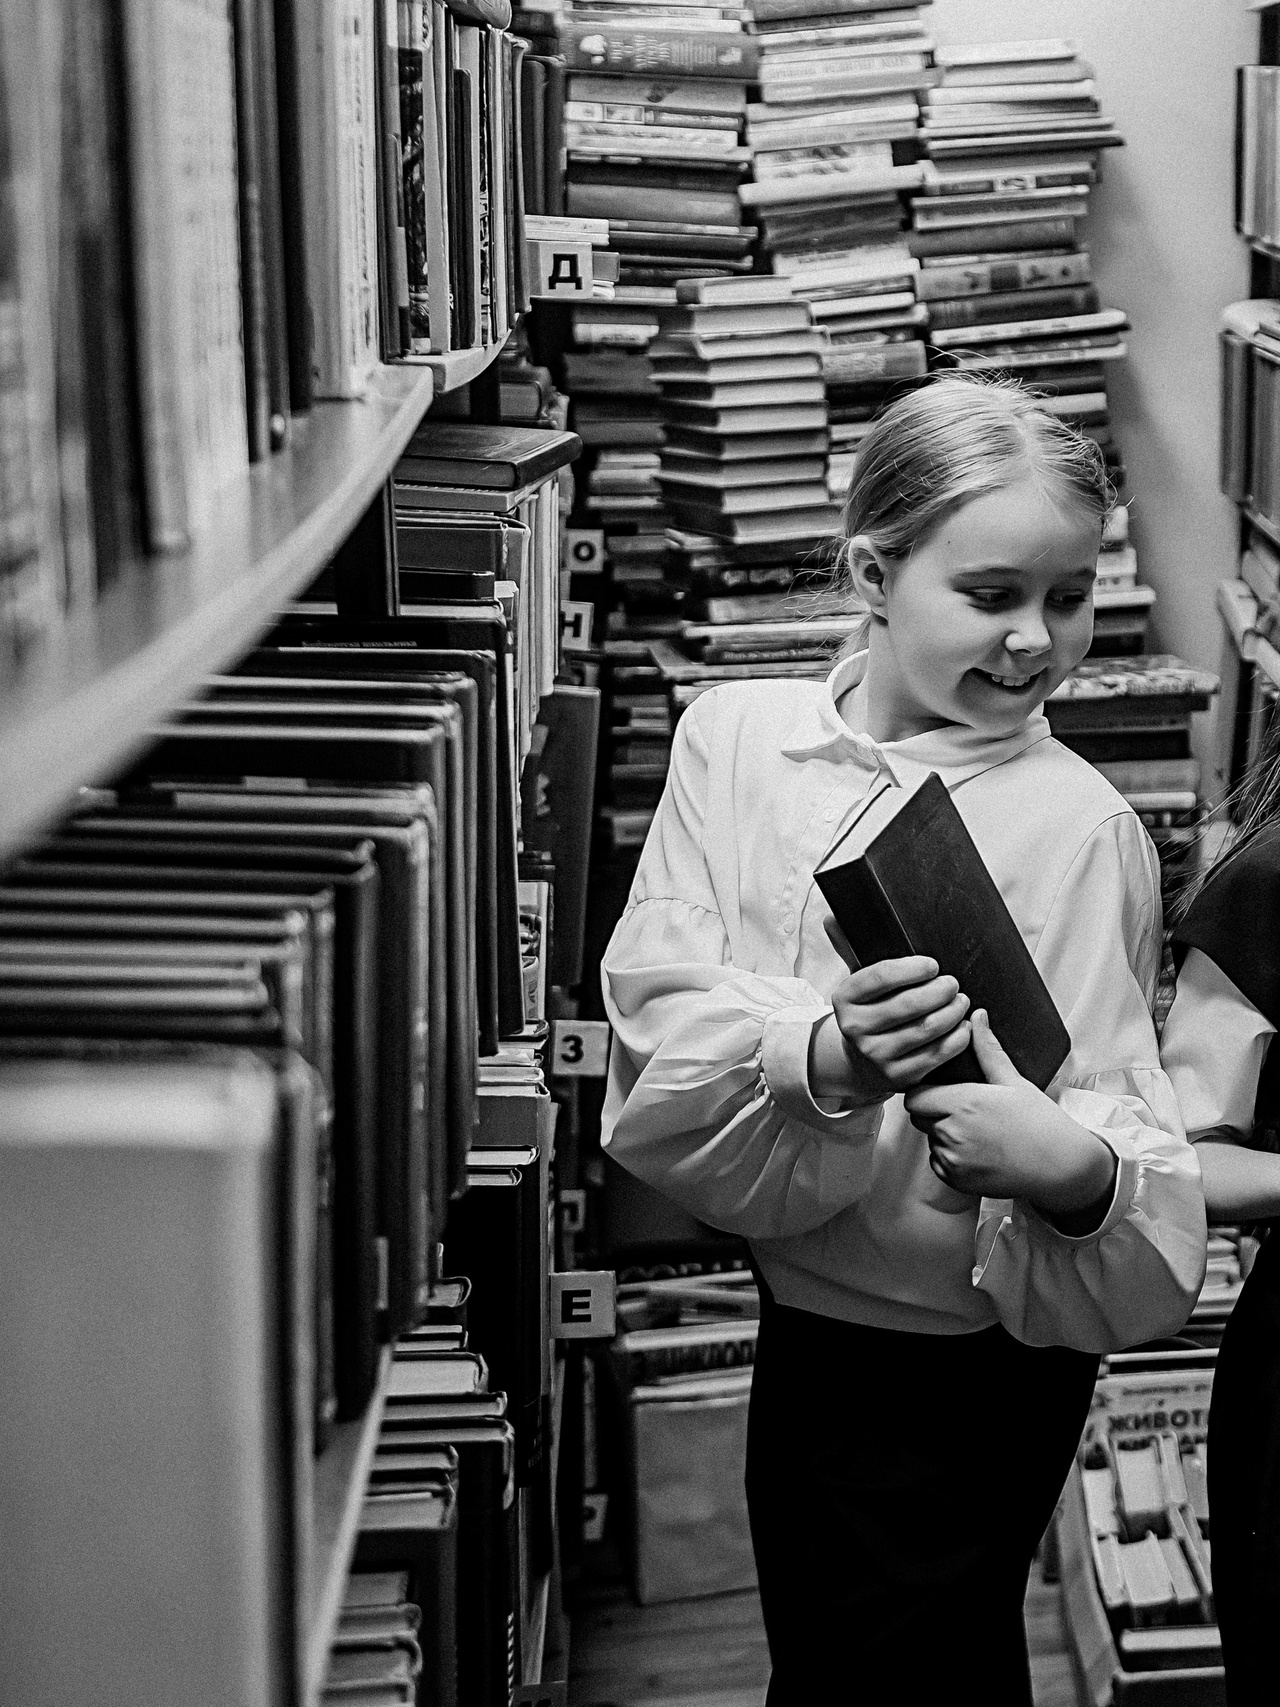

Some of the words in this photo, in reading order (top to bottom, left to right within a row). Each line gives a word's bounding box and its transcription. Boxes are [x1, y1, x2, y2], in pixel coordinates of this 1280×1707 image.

[548, 253, 583, 290] Д
[573, 540, 596, 562] О
[561, 1289, 592, 1324] Е
